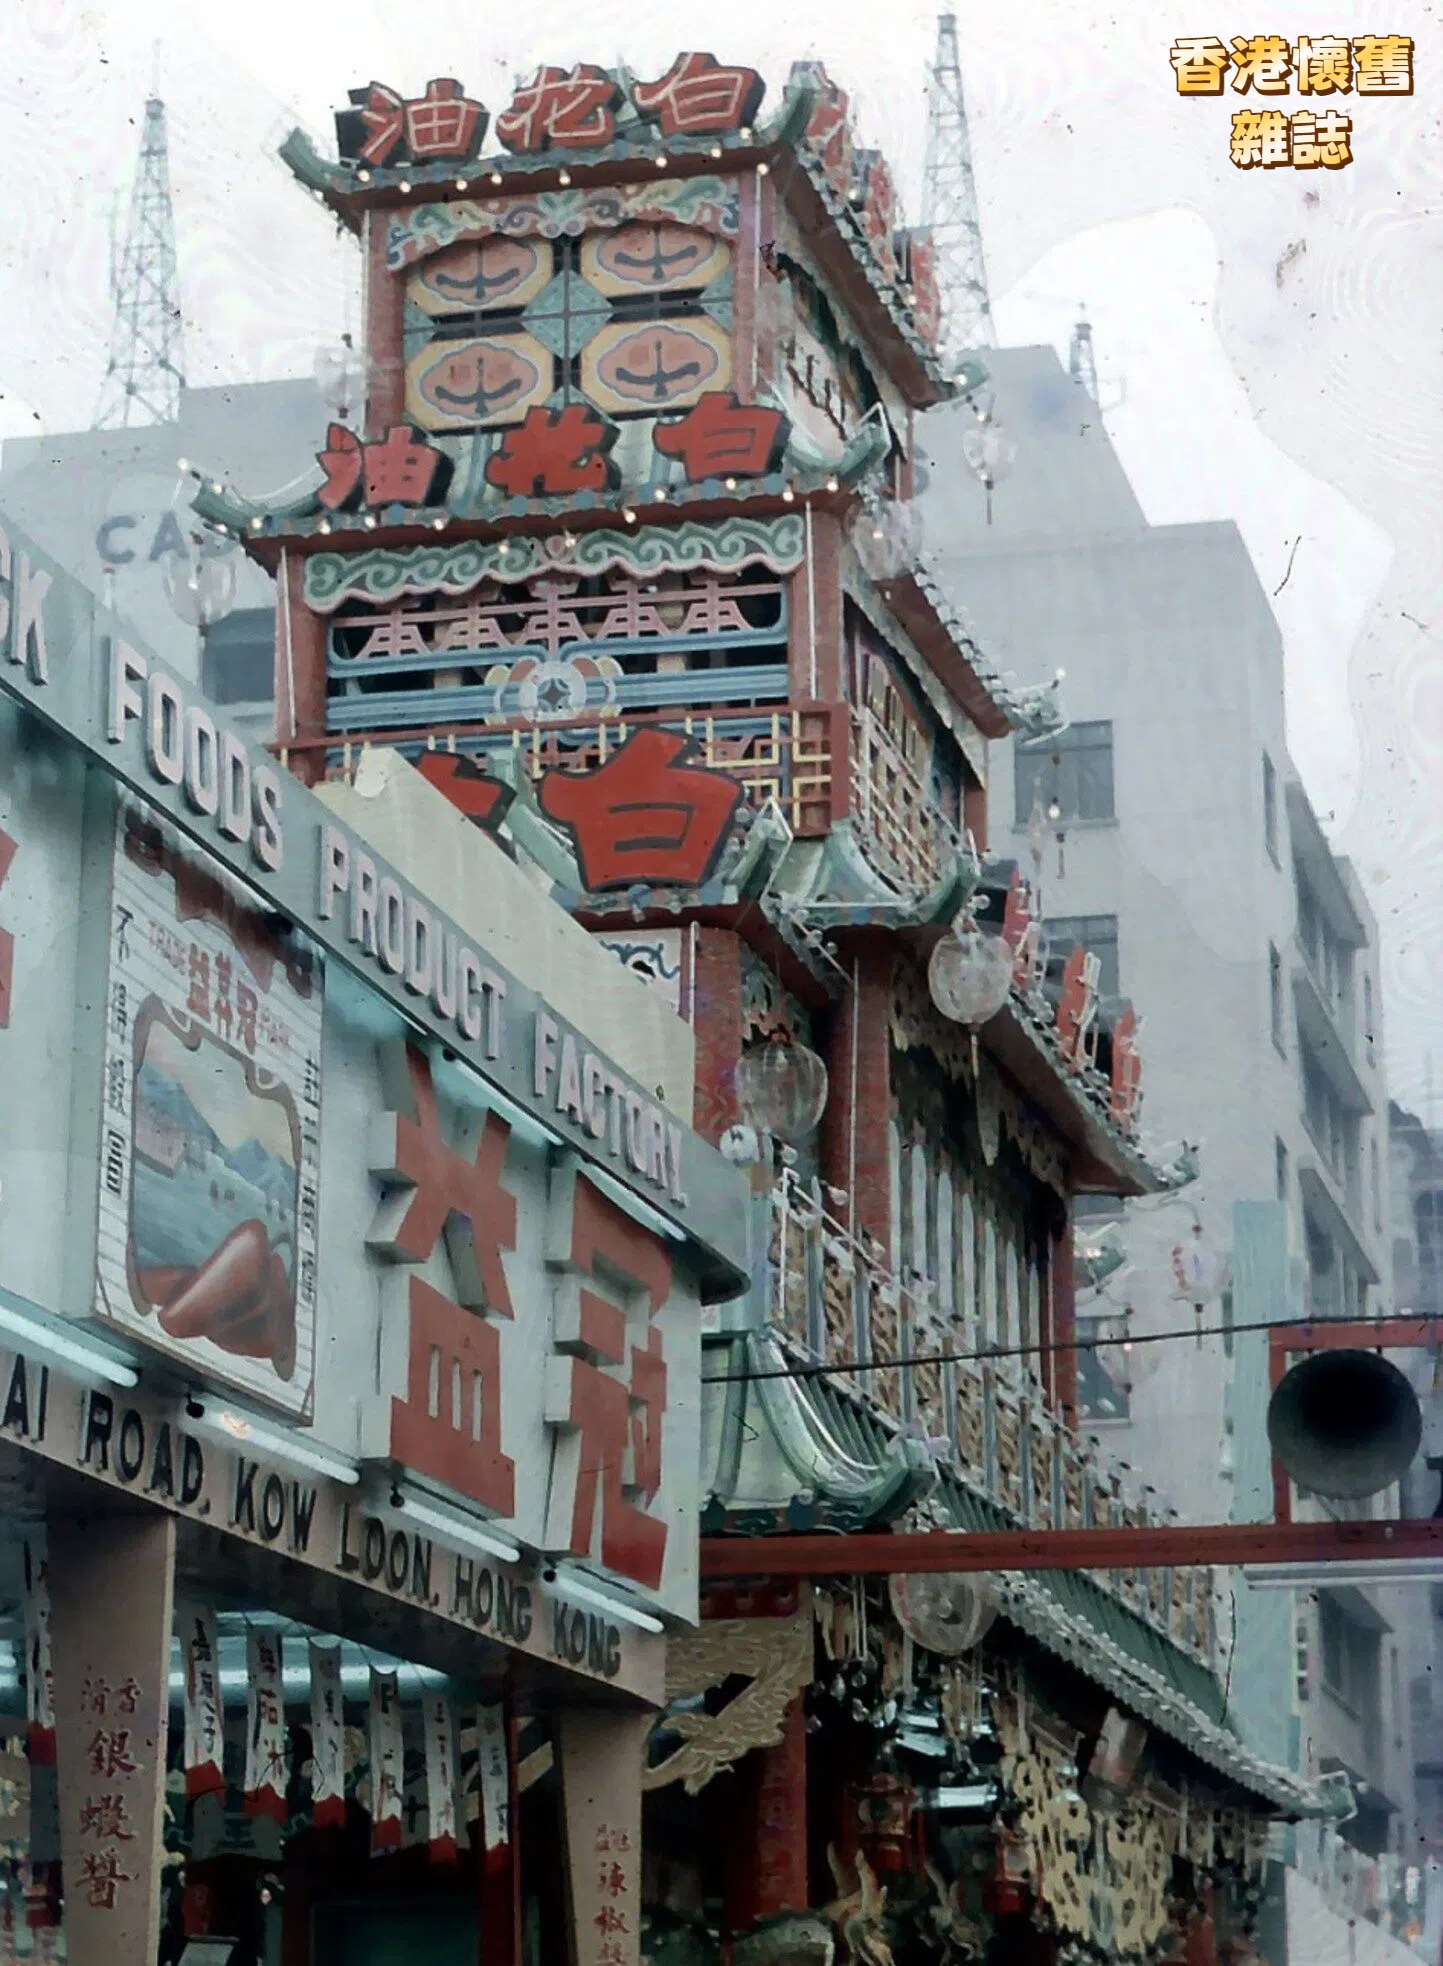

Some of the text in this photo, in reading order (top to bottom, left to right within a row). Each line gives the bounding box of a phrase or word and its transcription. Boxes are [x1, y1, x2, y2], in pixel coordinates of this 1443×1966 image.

[107, 637, 285, 873] FOODS
[317, 823, 508, 1062] PRODUCT
[227, 1454, 318, 1554] KOW
[449, 1552, 533, 1644] HONG
[551, 1597, 622, 1680] KONG
